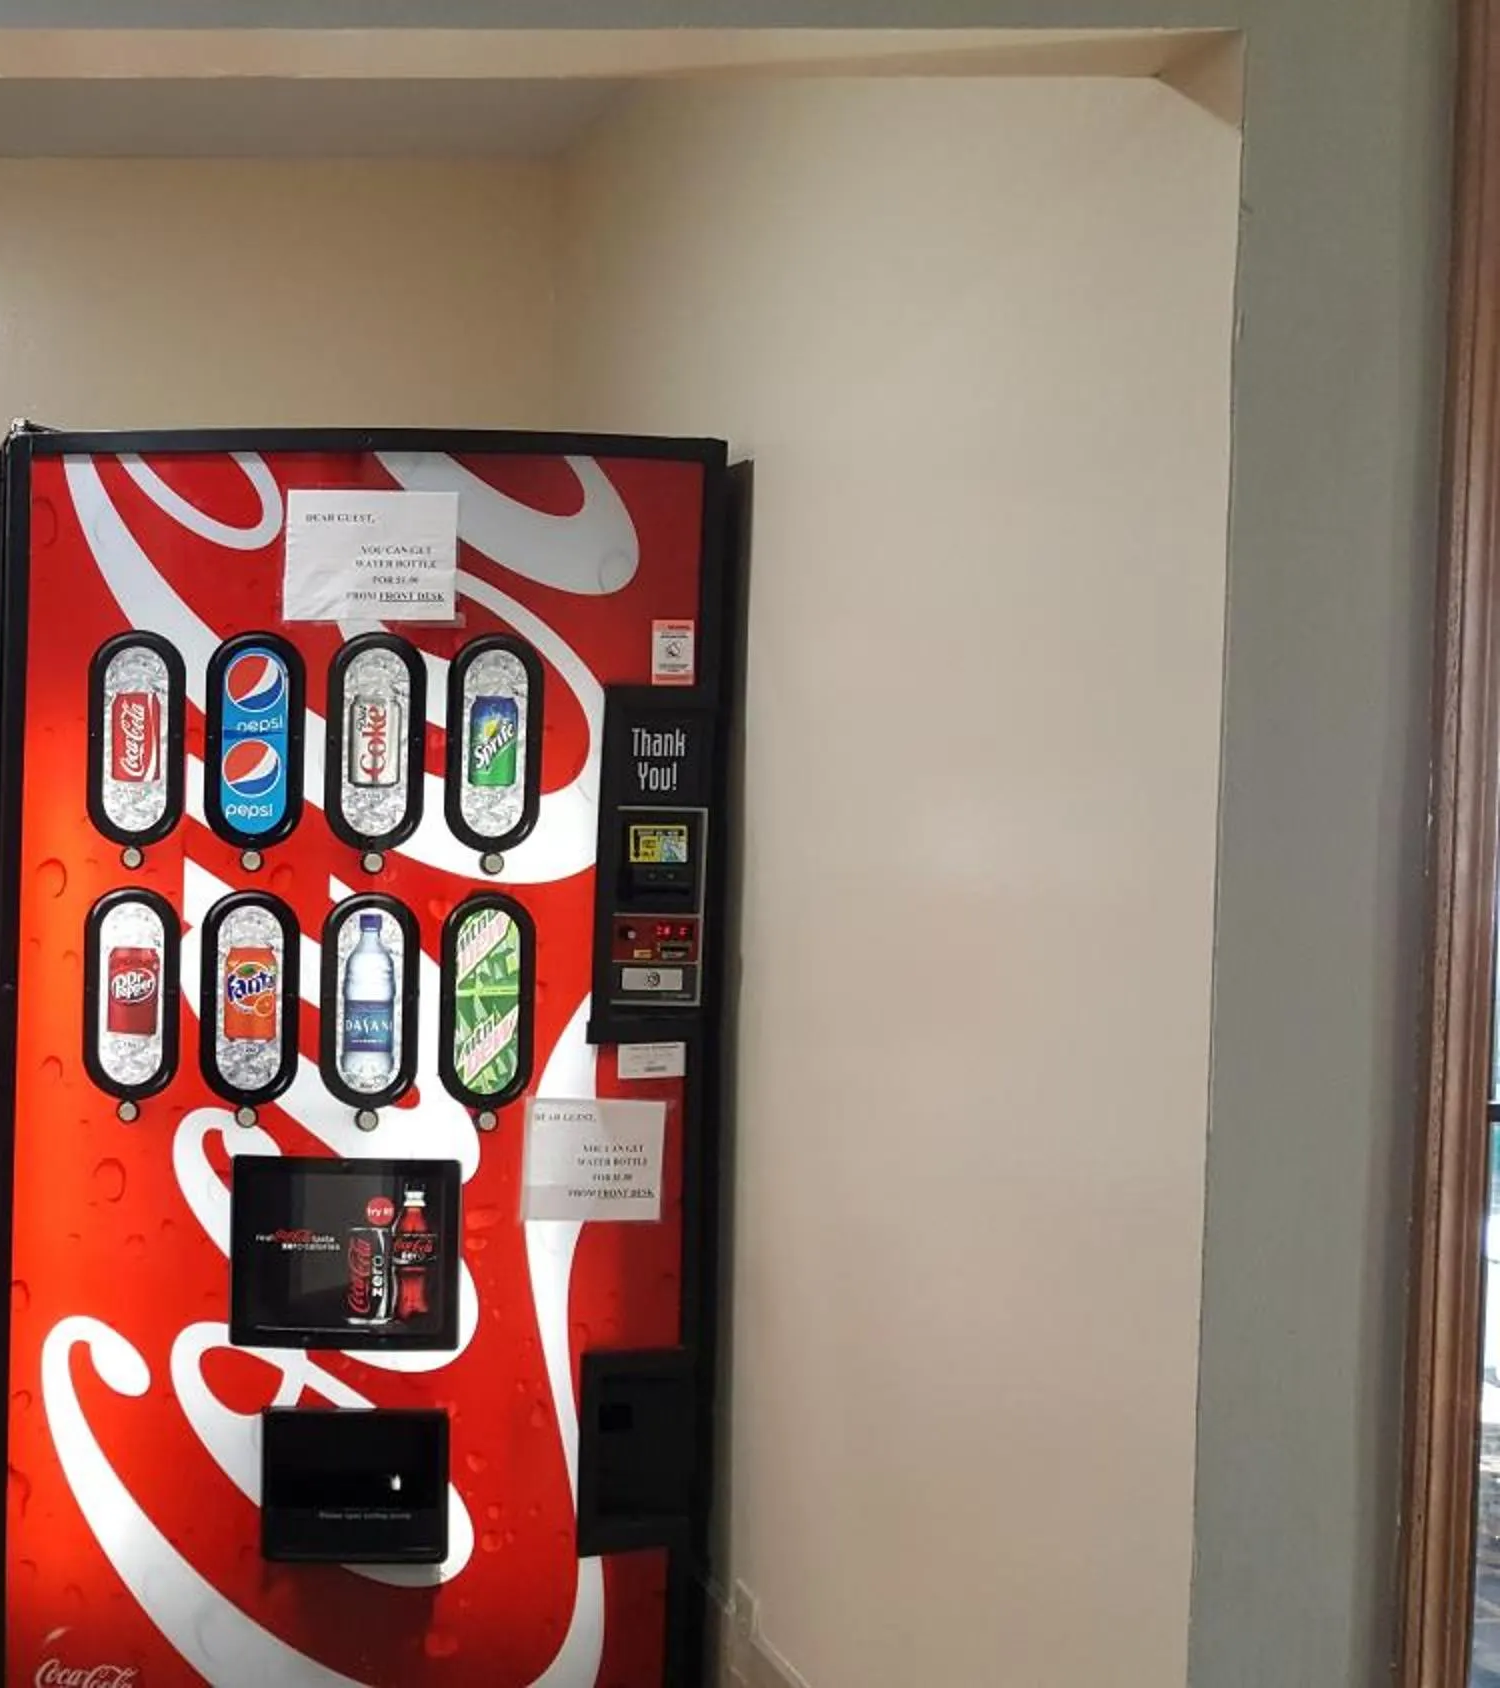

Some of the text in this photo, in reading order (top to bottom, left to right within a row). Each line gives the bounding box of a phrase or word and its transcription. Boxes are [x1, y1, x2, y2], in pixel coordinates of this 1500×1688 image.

[305, 513, 335, 522] DEAR
[361, 545, 432, 554] YOU CAN GET
[355, 559, 437, 569] WATER BOTTLE
[372, 575, 393, 584] FOR
[346, 591, 444, 602] FROM FRONT DESK
[359, 703, 387, 781] Coke
[473, 719, 516, 769] Sprite
[631, 727, 687, 757] Thank
[637, 761, 678, 791] You!
[225, 803, 274, 819] pepsi
[577, 1157, 649, 1167] WATER BOTTLE
[568, 1188, 655, 1199] FROM FRONT DESK
[367, 1206, 382, 1218] try
[371, 1254, 384, 1297] zero
